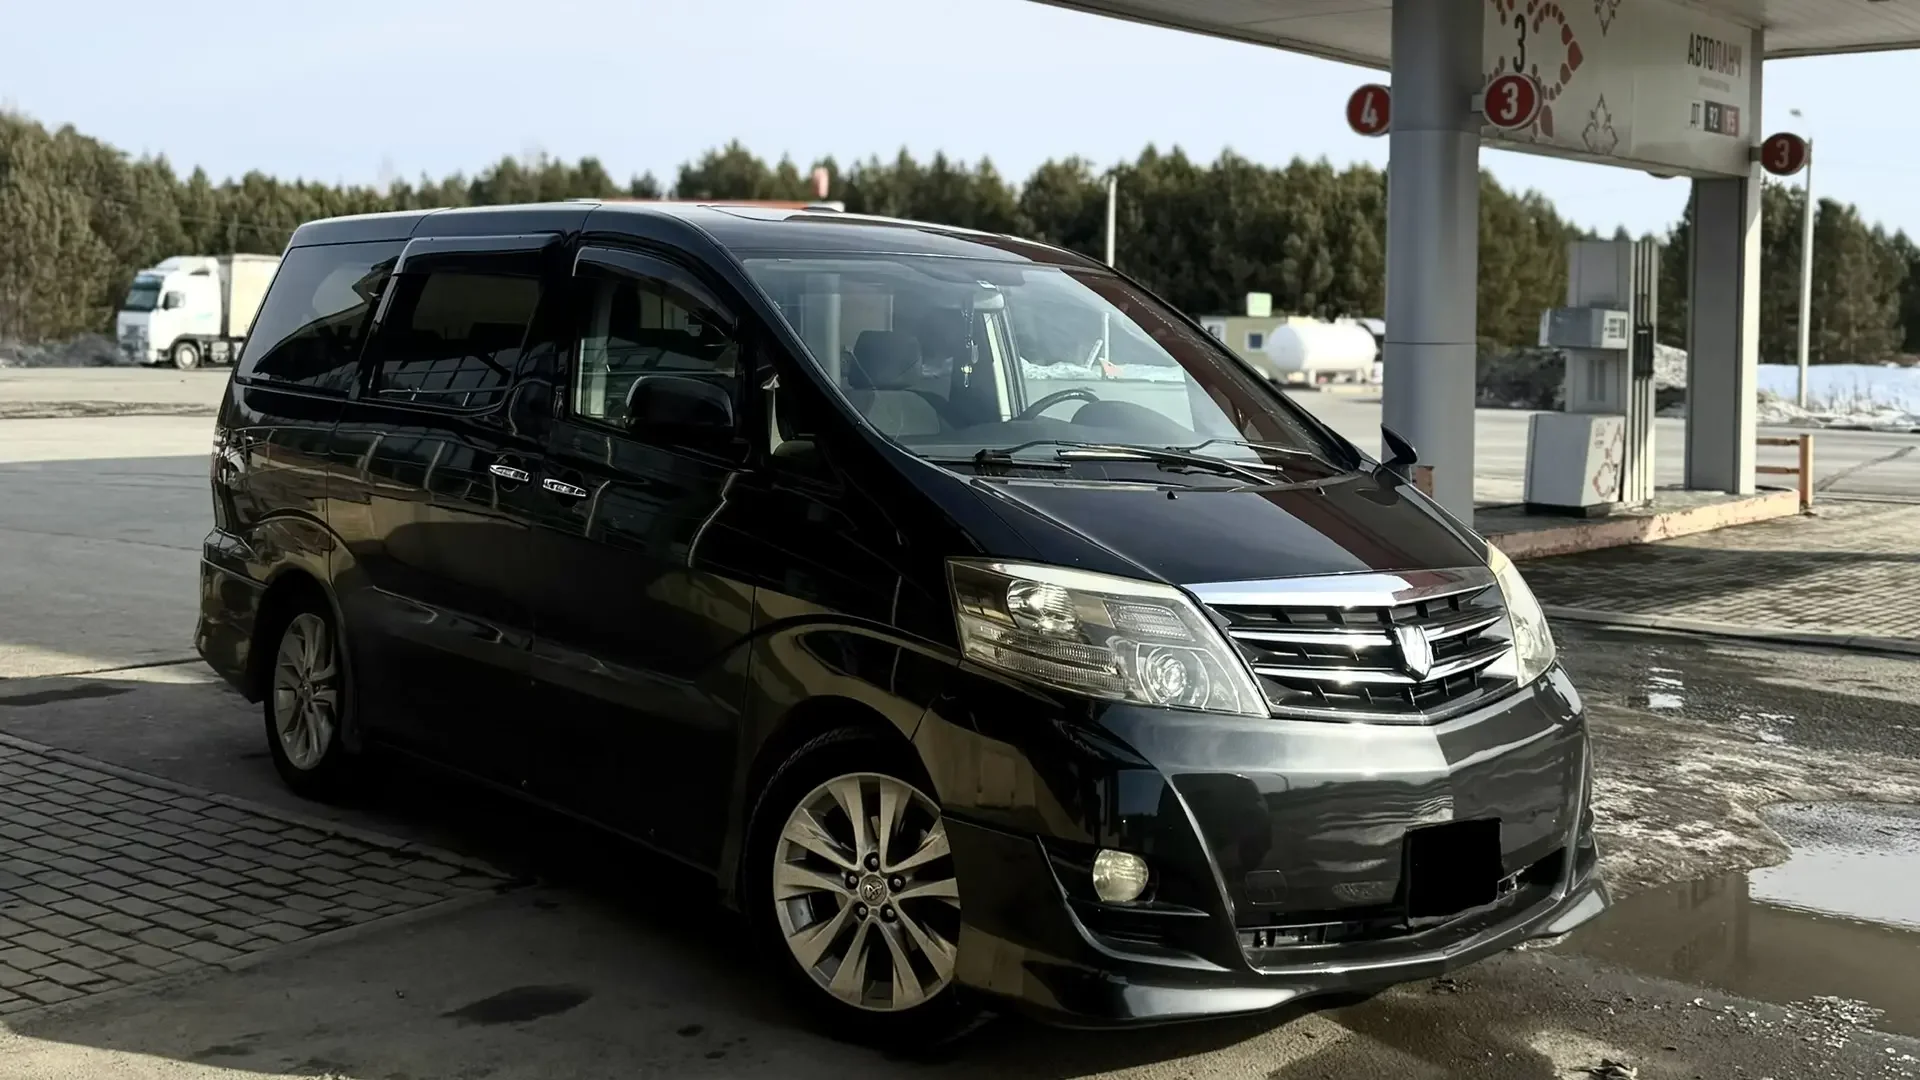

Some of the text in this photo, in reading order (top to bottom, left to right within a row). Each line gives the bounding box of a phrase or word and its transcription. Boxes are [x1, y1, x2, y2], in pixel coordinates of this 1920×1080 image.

[1513, 13, 1526, 73] 3
[1361, 91, 1378, 128] 4
[1500, 82, 1519, 120] 3
[1774, 139, 1790, 168] 3
